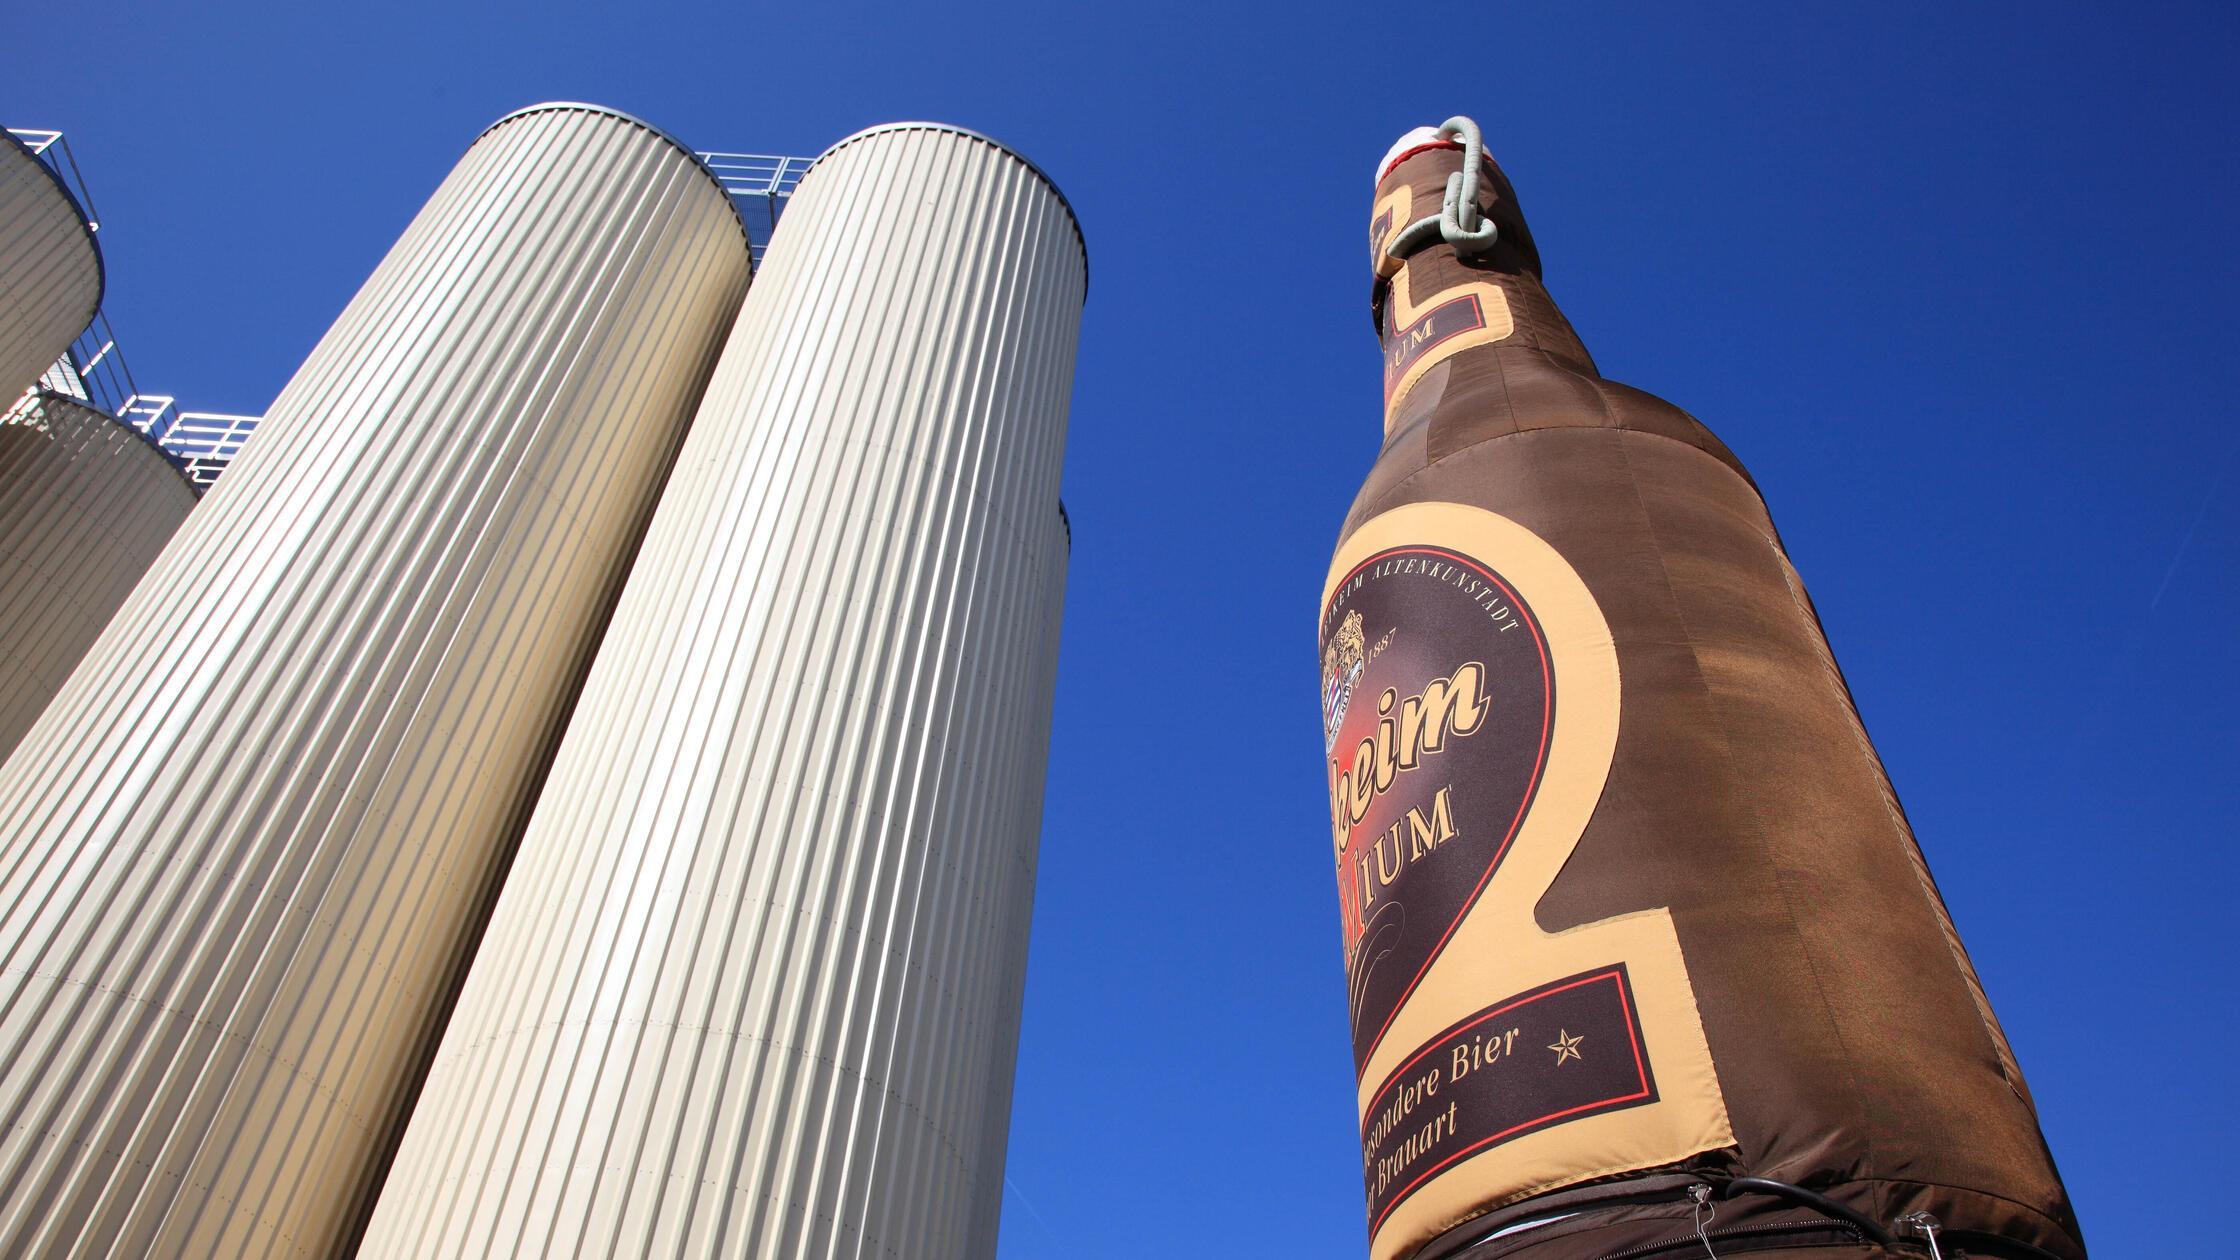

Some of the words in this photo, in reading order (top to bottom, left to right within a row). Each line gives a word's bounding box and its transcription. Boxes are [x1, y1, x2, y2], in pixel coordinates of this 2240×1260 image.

[1387, 317, 1435, 379] IUM
[1372, 558, 1519, 633] ALTENKUNSTADT
[1368, 627, 1397, 665] 1887
[1450, 1027, 1520, 1084] Bier
[1377, 1101, 1458, 1198] Brauart
